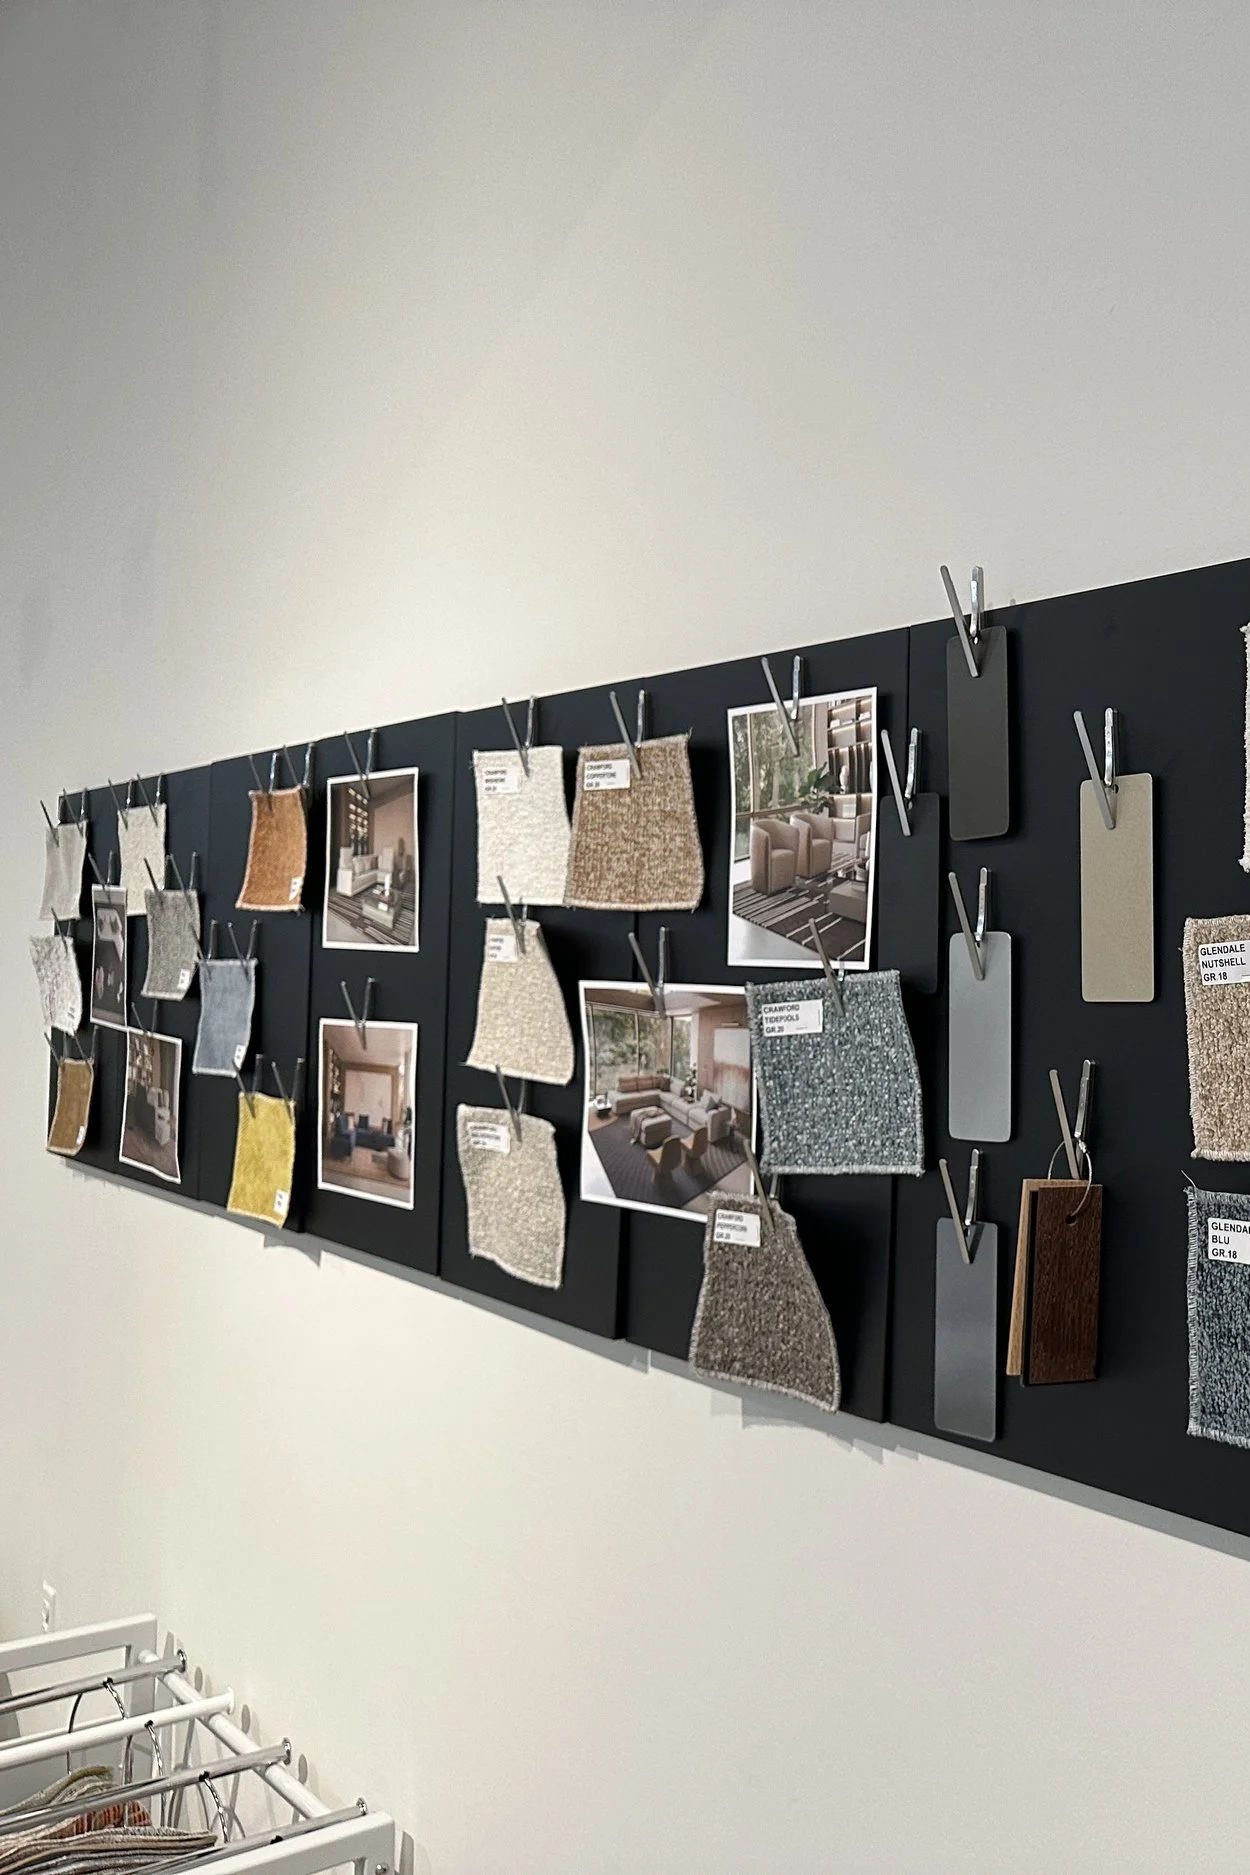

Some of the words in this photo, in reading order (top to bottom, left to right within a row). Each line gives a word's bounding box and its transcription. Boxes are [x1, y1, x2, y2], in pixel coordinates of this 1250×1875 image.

[1200, 943, 1246, 956] GLENDALE
[1201, 957, 1247, 969] NUTSHELL
[763, 1003, 800, 1014] CRAWFORD
[764, 1013, 800, 1024] TIDEPOOLS
[1211, 1234, 1230, 1245] BLU
[1211, 1247, 1238, 1260] GR.18
